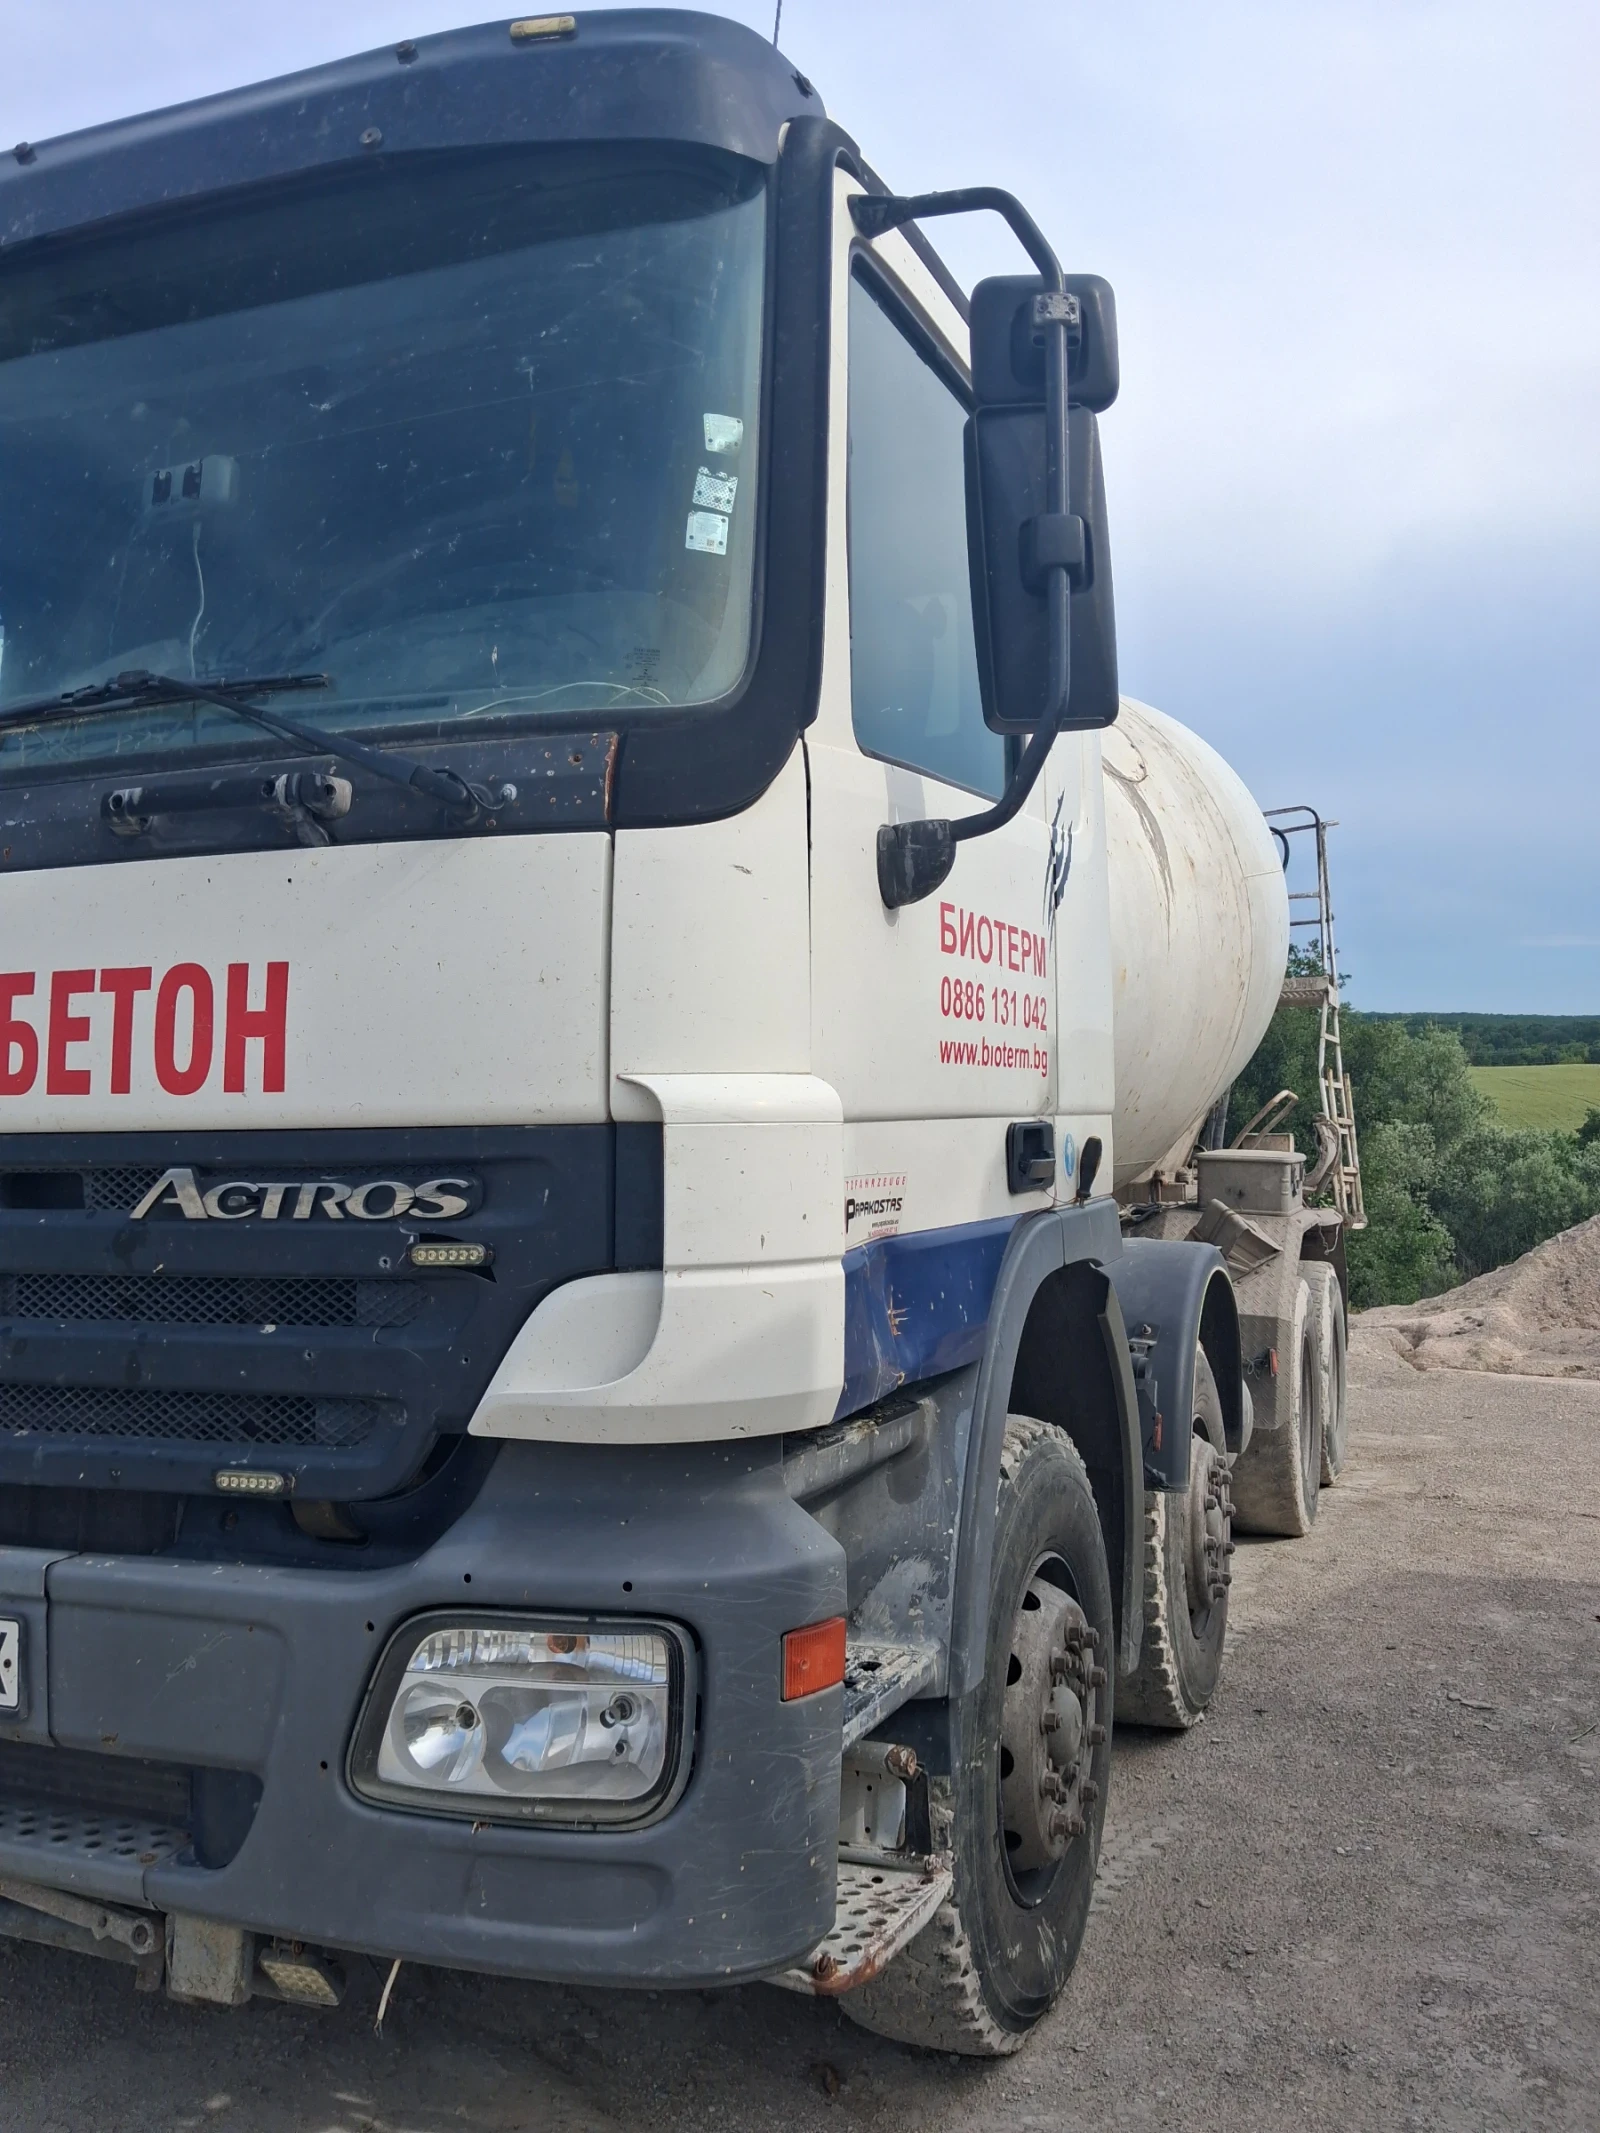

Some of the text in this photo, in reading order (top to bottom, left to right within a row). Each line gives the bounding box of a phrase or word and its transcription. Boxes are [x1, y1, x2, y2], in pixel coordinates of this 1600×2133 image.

[940, 901, 1046, 978] БИОТЕРМ
[0, 961, 289, 1096] БЕТОН
[941, 976, 1047, 1031] 0886 131 042
[939, 1036, 1048, 1077] www.bioterm.bg
